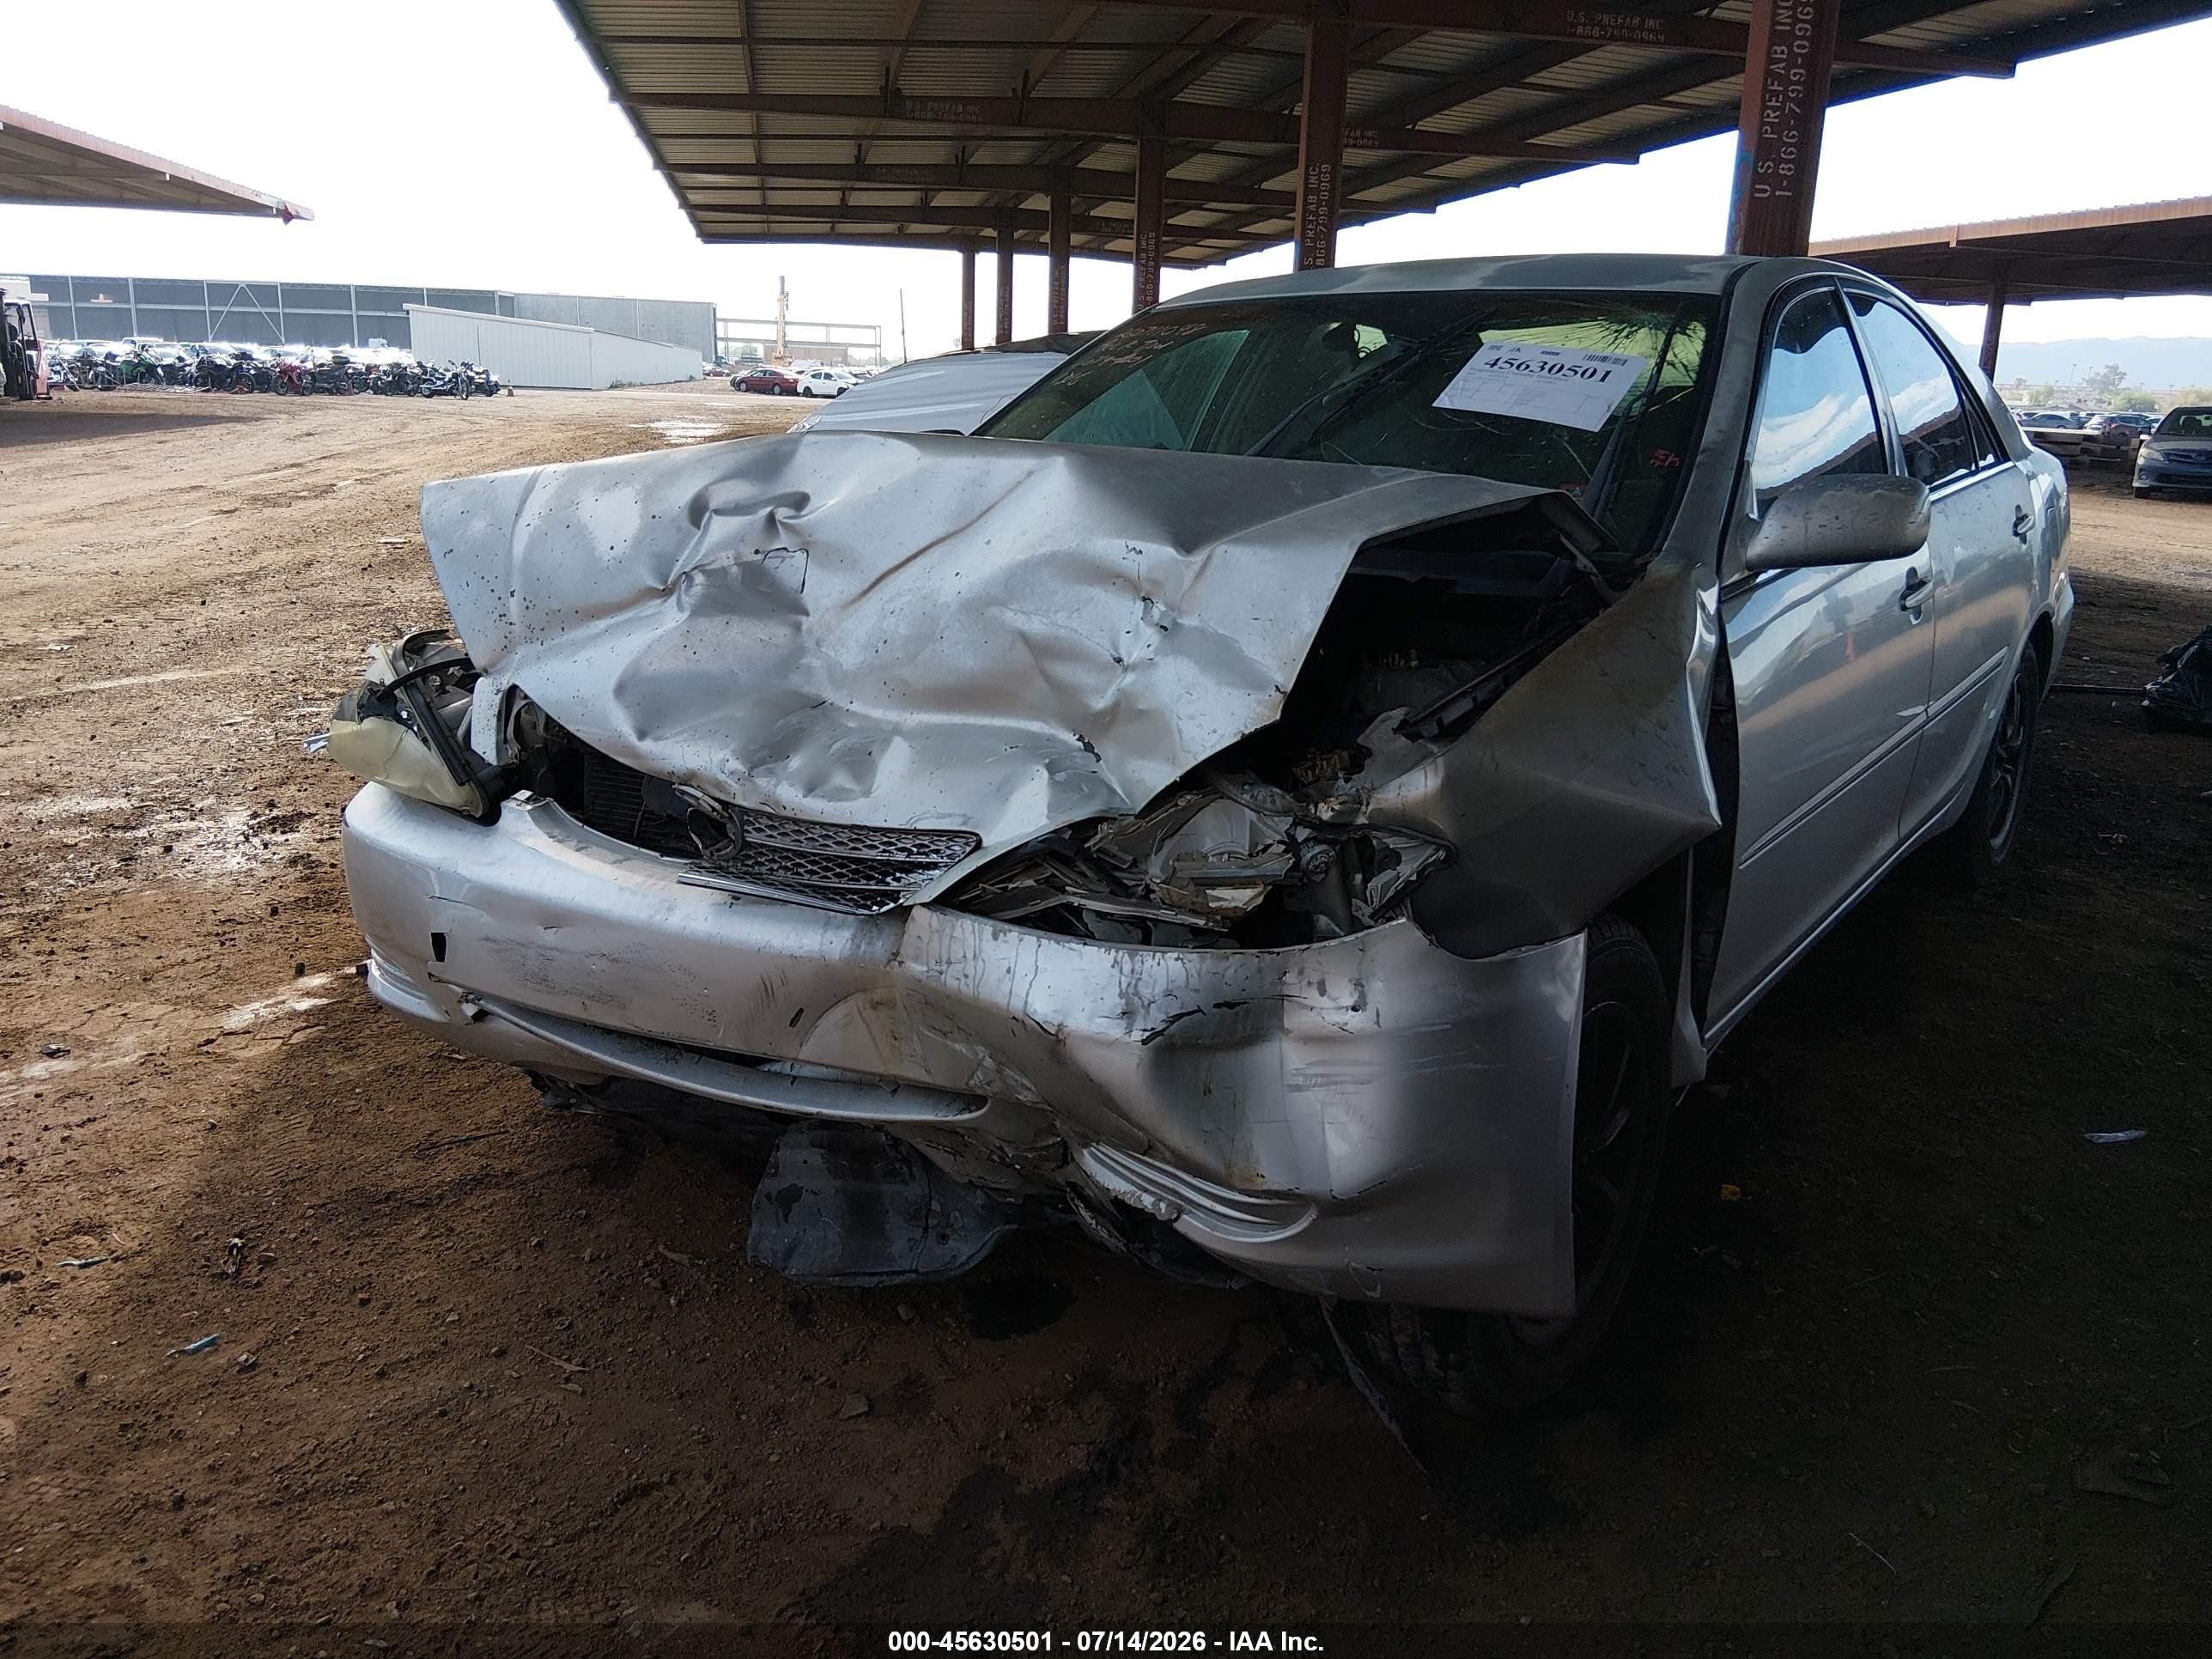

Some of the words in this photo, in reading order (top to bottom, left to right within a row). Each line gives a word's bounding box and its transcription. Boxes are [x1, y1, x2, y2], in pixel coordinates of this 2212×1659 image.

[1762, 46, 1788, 138] PREFAB
[1775, 0, 1814, 196] 1-866-799-096
[1309, 162, 1320, 187] INC.
[1305, 195, 1317, 246] PREFAB
[1316, 164, 1331, 266] 866-799-0969
[1146, 232, 1156, 307] -866-799-0969
[1484, 356, 1613, 383] 45630501
